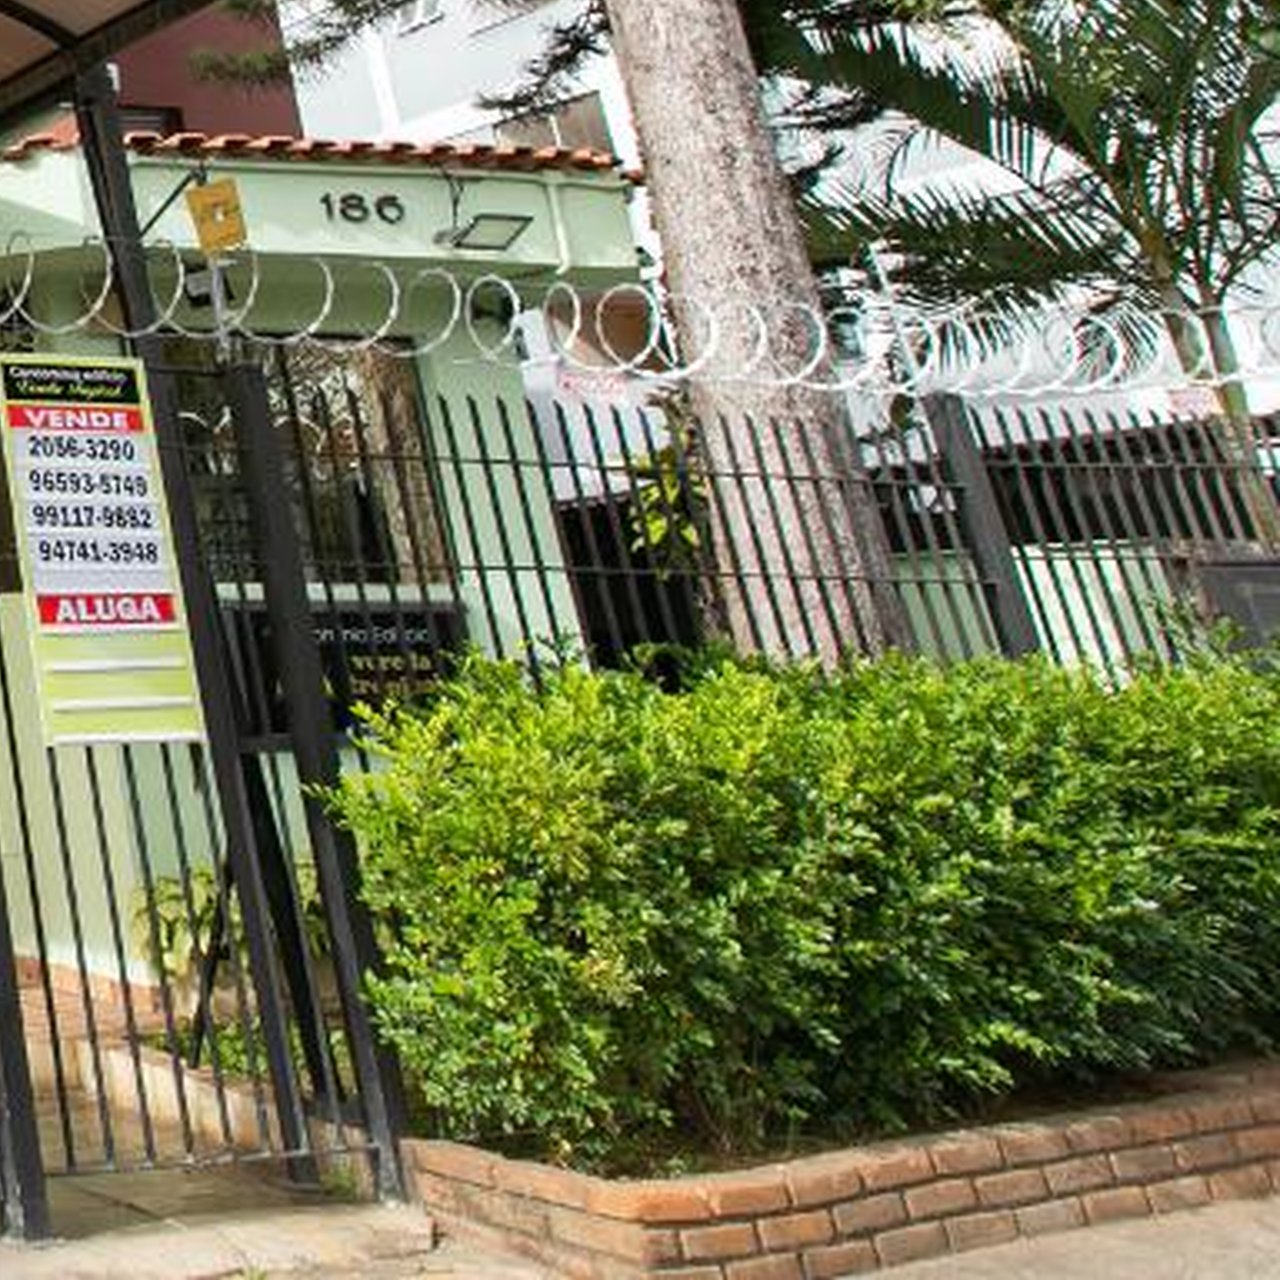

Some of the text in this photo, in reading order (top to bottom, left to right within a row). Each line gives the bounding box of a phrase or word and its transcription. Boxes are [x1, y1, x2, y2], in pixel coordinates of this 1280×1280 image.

[319, 193, 405, 225] 186
[24, 409, 128, 429] VENDE
[55, 596, 163, 622] ALUGA
